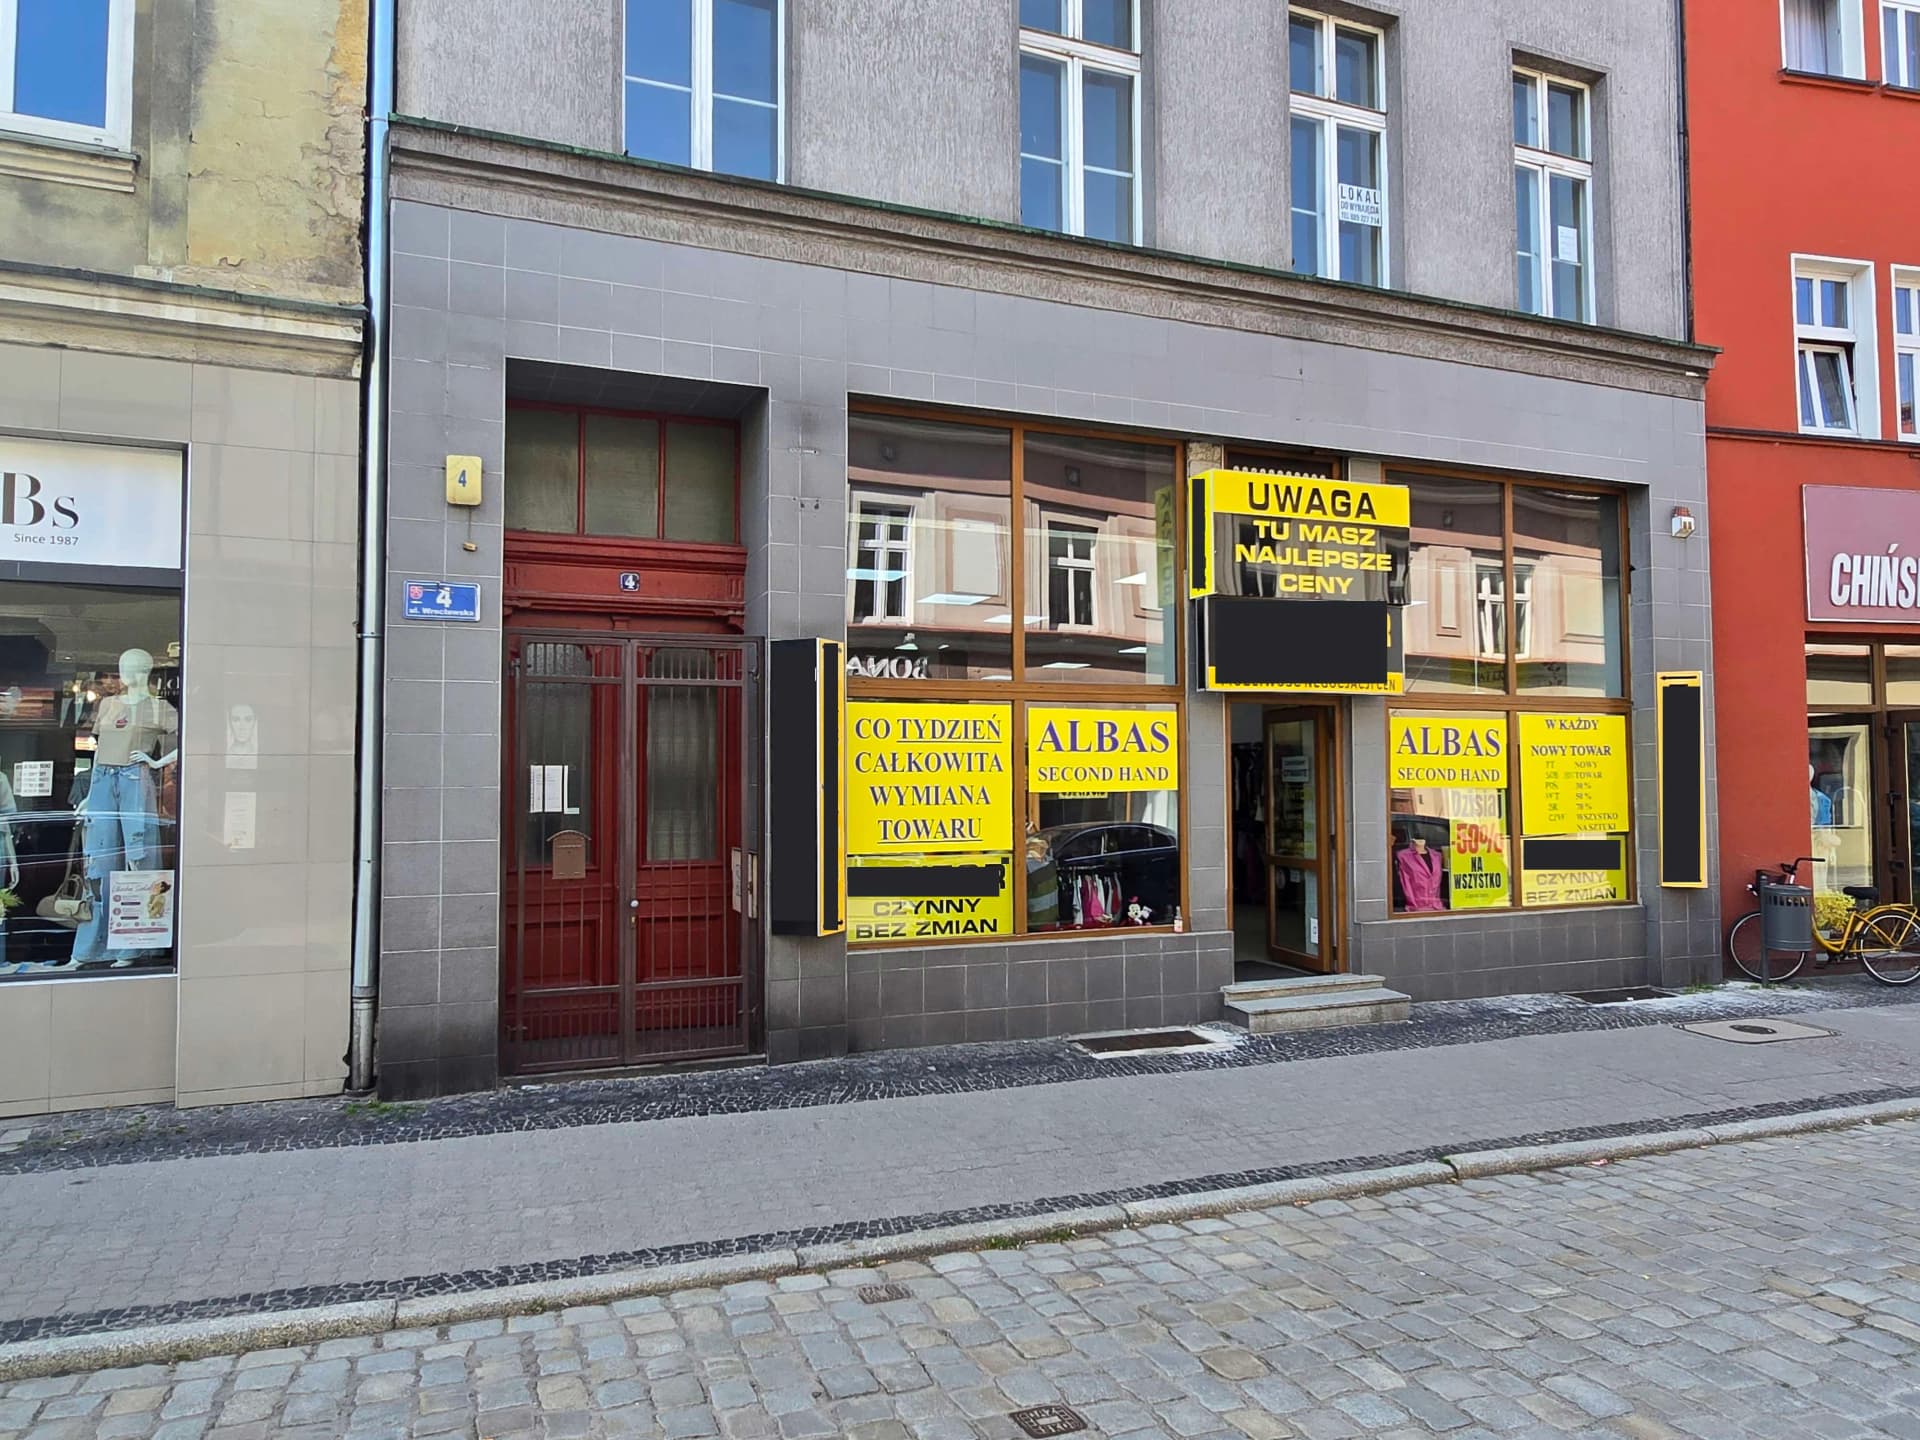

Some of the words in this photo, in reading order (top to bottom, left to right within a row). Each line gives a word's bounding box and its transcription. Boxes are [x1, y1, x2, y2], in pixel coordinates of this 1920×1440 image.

[1340, 186, 1379, 205] LOKAL
[1340, 200, 1349, 210] DO
[458, 470, 467, 487] 4
[2, 472, 79, 529] Bs
[1248, 482, 1377, 520] UWAGA
[14, 533, 46, 543] Since
[50, 535, 79, 545] 1987
[1253, 520, 1290, 540] TU
[1299, 524, 1376, 546] MASZ
[1235, 544, 1392, 571] NAJLEPSZE
[624, 575, 636, 589] 4
[1279, 573, 1353, 594] CENY
[1830, 543, 1920, 609] CHIŃS
[436, 587, 453, 608] 4
[855, 718, 891, 740] CO
[897, 714, 1002, 740] TYDZIEŃ
[1545, 719, 1556, 730] W
[1559, 717, 1599, 730] KAŻDY
[1037, 720, 1170, 753] ALBAS
[1397, 726, 1501, 757] ALBAS
[1531, 745, 1567, 757] NOWY
[1569, 745, 1612, 756] TOWAR
[855, 752, 1003, 773] CAŁKOWITA
[1575, 761, 1598, 769] NOWY
[1037, 766, 1113, 782] SECOND
[1119, 766, 1169, 781] HAND
[1398, 767, 1457, 781] SECOND
[1461, 768, 1500, 782] HAND
[1574, 771, 1602, 779] TOWAR
[869, 785, 991, 806] WYMIANA
[1576, 812, 1618, 821] WSZYSTKO
[878, 818, 981, 840] TOWARU
[1471, 857, 1483, 872] NA
[1454, 873, 1501, 889] WSZYSTKO
[1536, 871, 1605, 885] CZYNNY
[1526, 890, 1557, 903] BEZ
[1565, 887, 1617, 900] ZMIAN
[874, 898, 981, 916] CZYNNY
[855, 923, 906, 938] BEZ
[916, 919, 998, 936] ZMIAN
